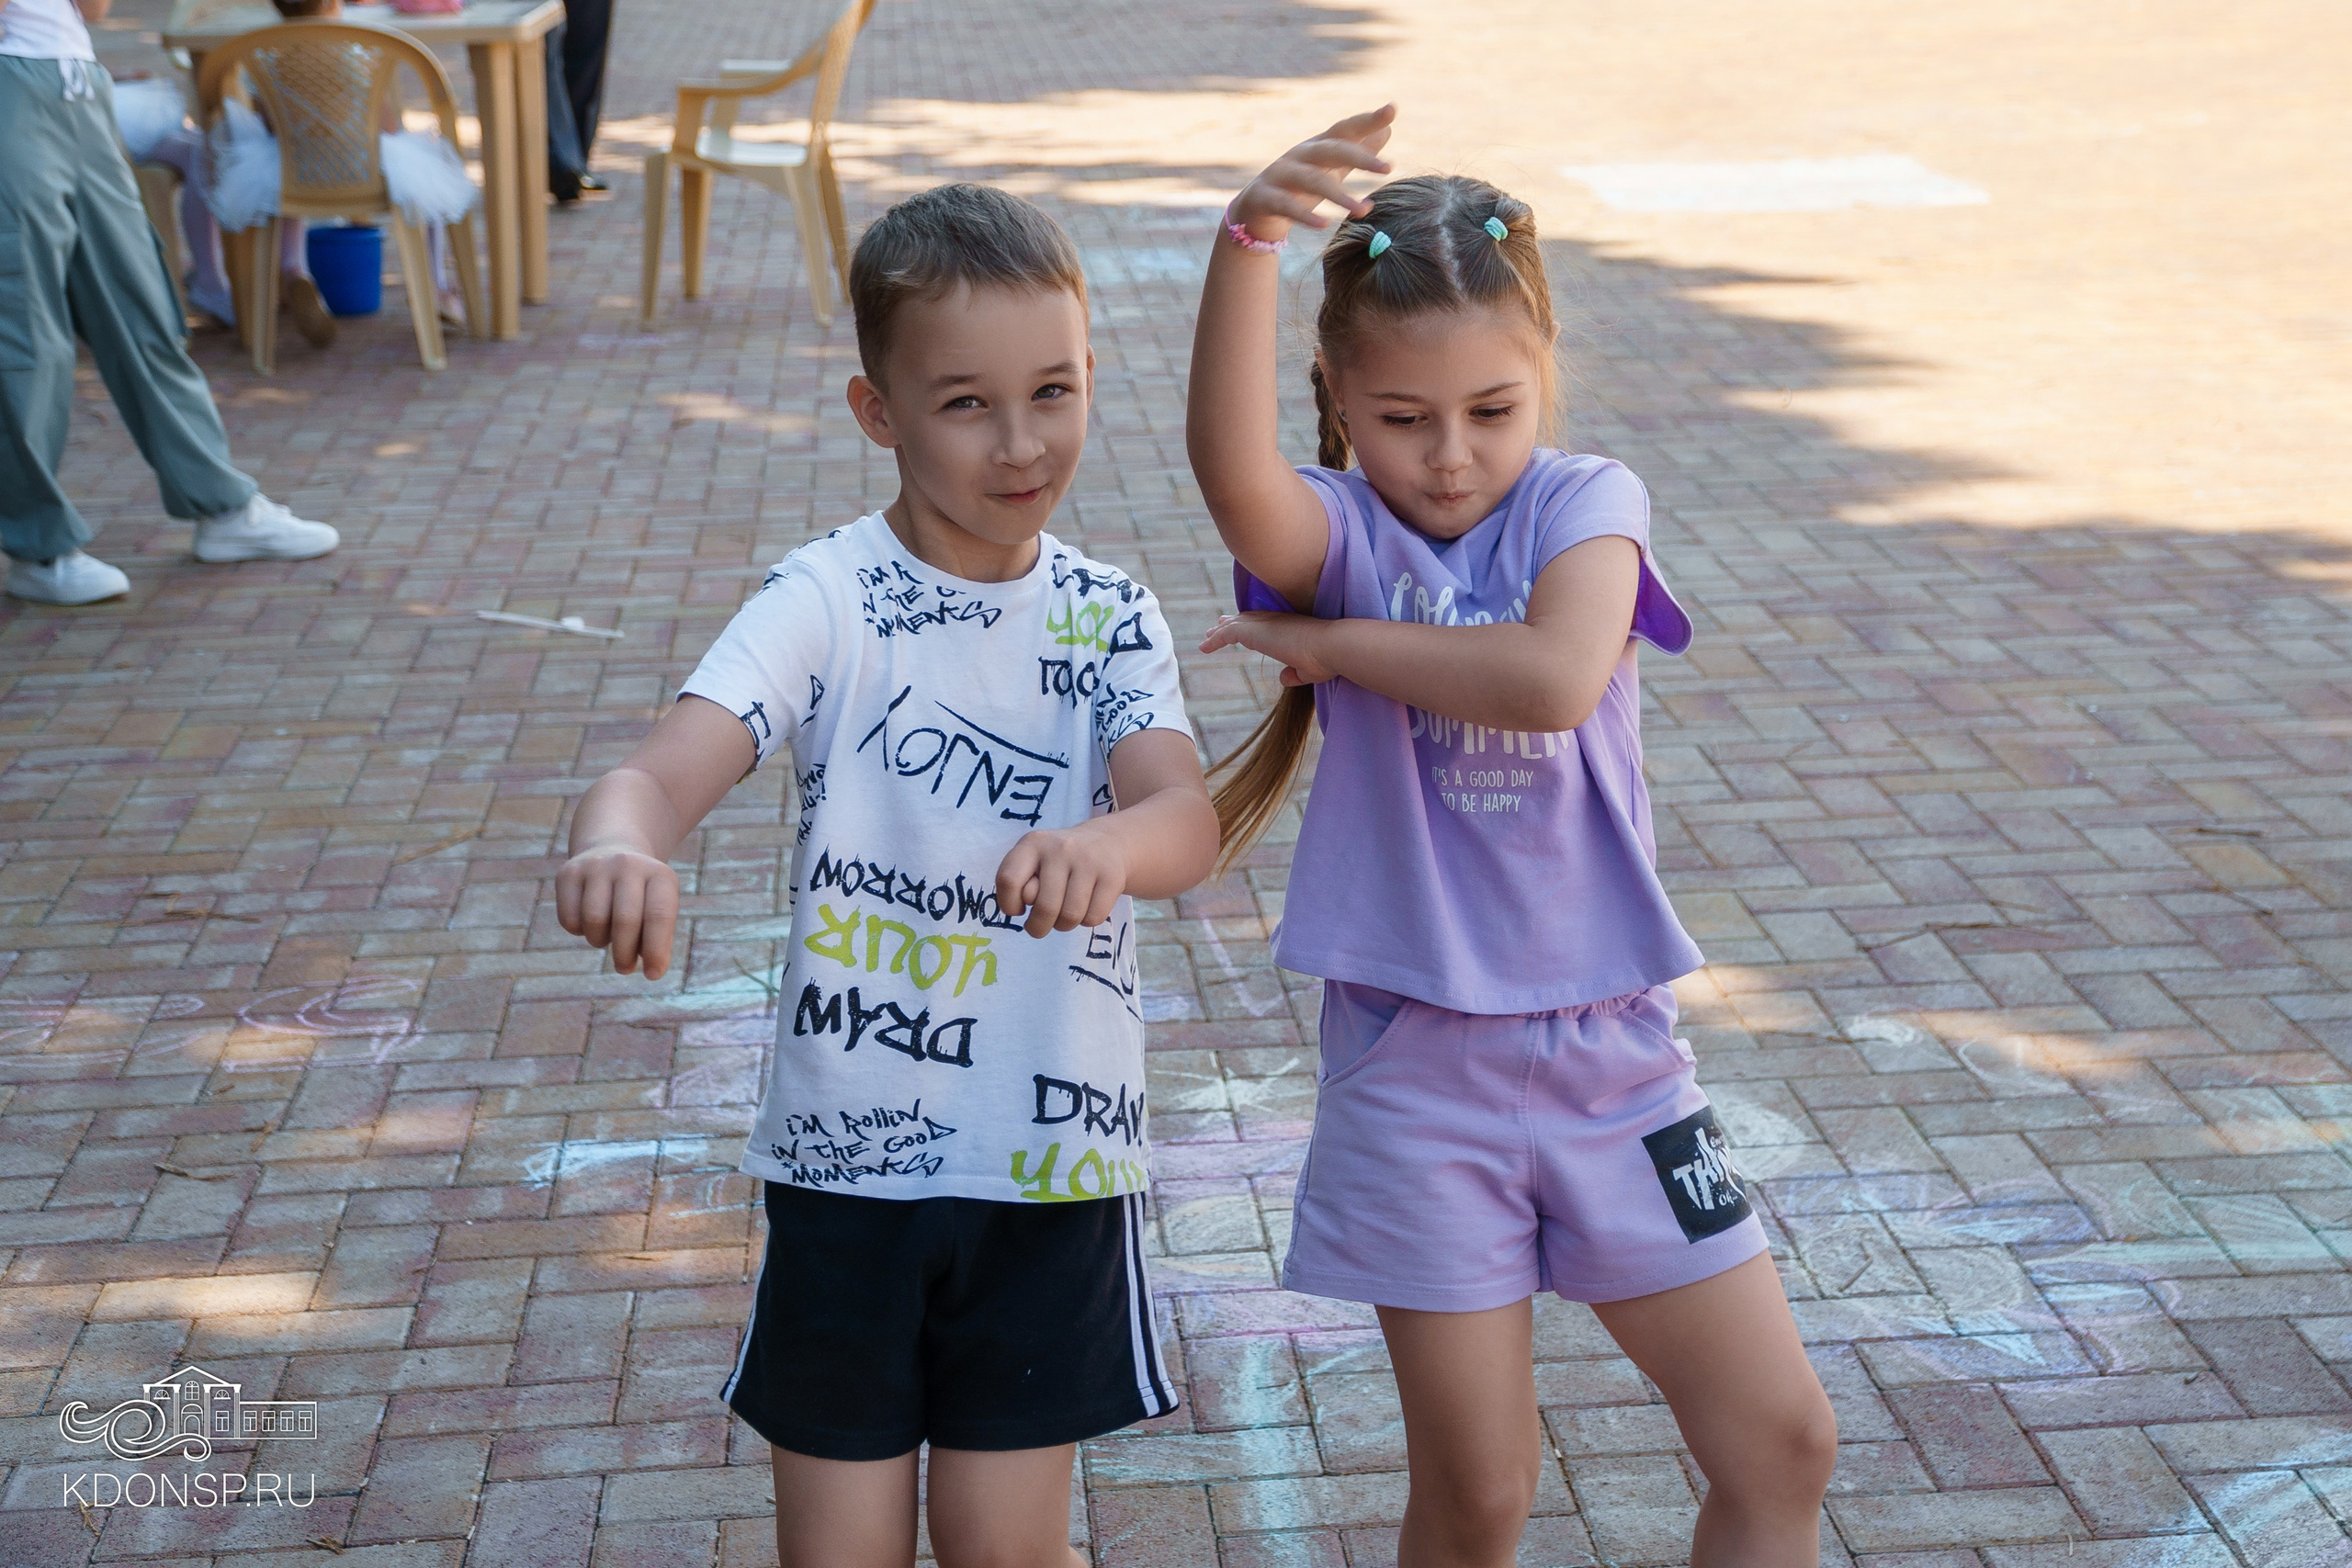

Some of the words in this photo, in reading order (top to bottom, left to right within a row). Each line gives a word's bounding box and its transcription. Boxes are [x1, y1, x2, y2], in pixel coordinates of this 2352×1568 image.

[856, 684, 1055, 828] ENJOY
[1431, 766, 1447, 787] IT'S
[1454, 769, 1464, 787] A
[1470, 770, 1505, 788] GOOD
[1510, 769, 1534, 788] DAY
[1441, 792, 1456, 812] TO
[1462, 793, 1477, 813] BE
[1483, 792, 1522, 813] HAPPY
[809, 843, 1024, 933] TOMORROW
[803, 903, 999, 998] YOUR
[793, 976, 979, 1068] DRAW
